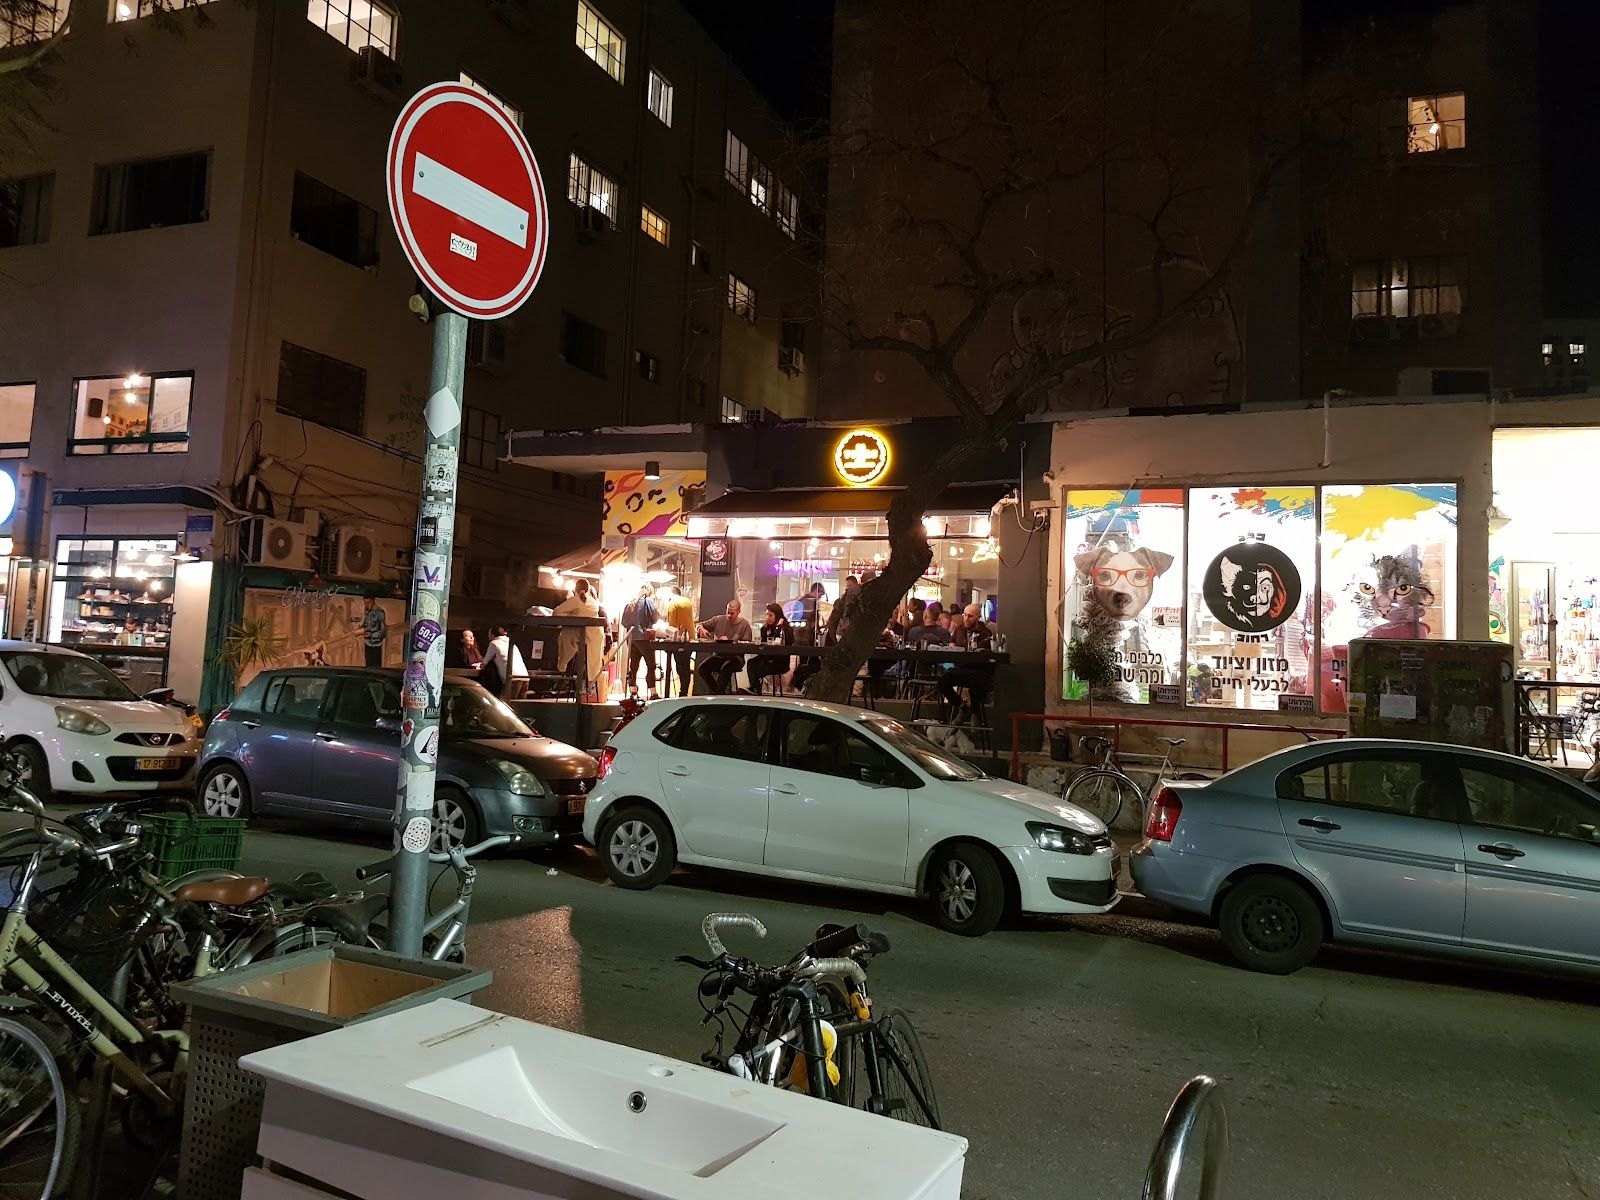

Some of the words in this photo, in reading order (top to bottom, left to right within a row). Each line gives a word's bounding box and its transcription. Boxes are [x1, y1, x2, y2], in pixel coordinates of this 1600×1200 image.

[418, 626, 436, 642] 50:1
[1237, 633, 1270, 643] רחוב
[1212, 656, 1250, 670] וציוד
[1256, 657, 1289, 674] מזון
[1140, 669, 1164, 684] ומה
[1211, 677, 1242, 690] חיים
[1248, 676, 1289, 692] לבעלי
[51, 990, 92, 1030] EVOKE
